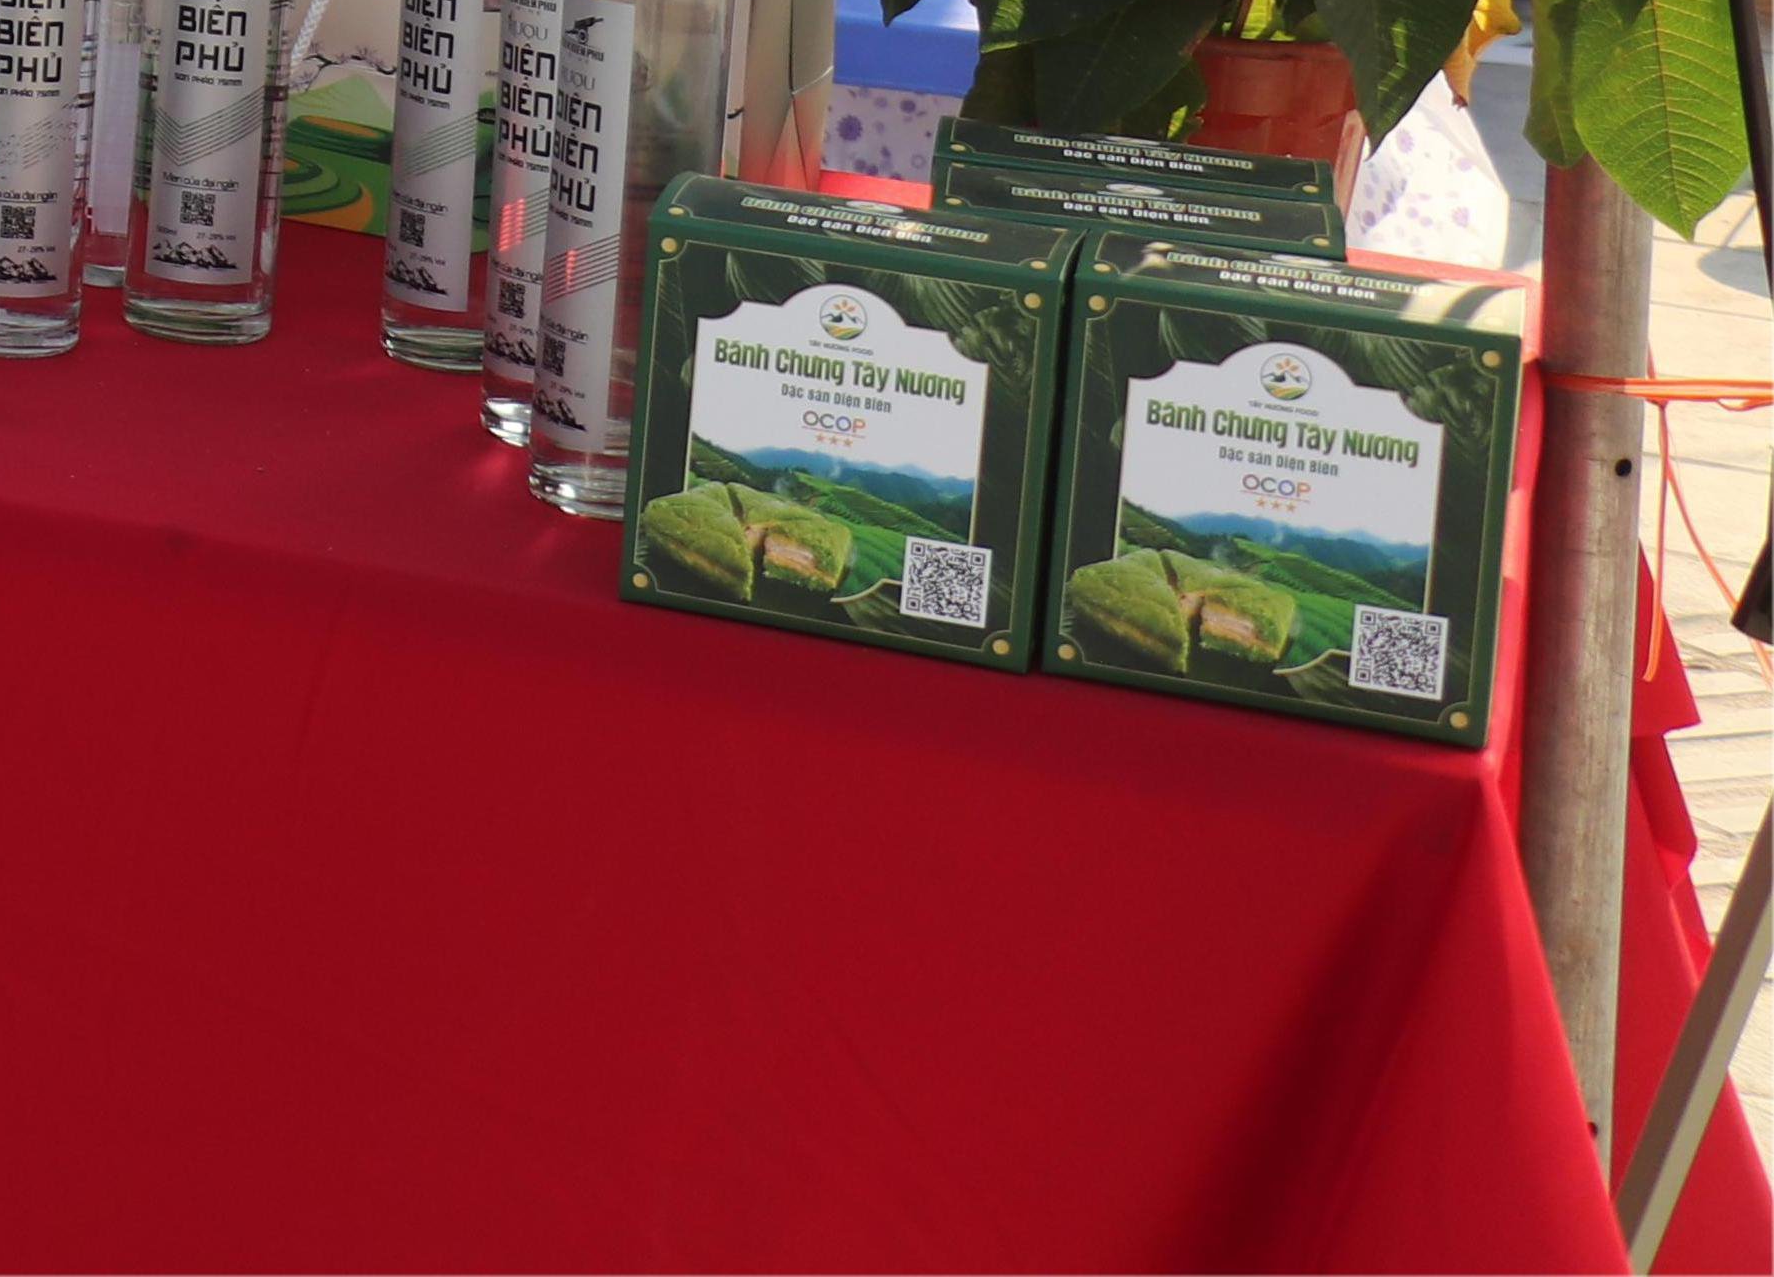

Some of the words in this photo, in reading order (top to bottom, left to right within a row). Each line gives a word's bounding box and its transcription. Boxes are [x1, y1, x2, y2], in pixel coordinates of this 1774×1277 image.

[714, 338, 770, 371] Bánh
[803, 410, 866, 433] OCOP
[1146, 399, 1206, 433] Bánh
[1242, 473, 1311, 497] OCOP
